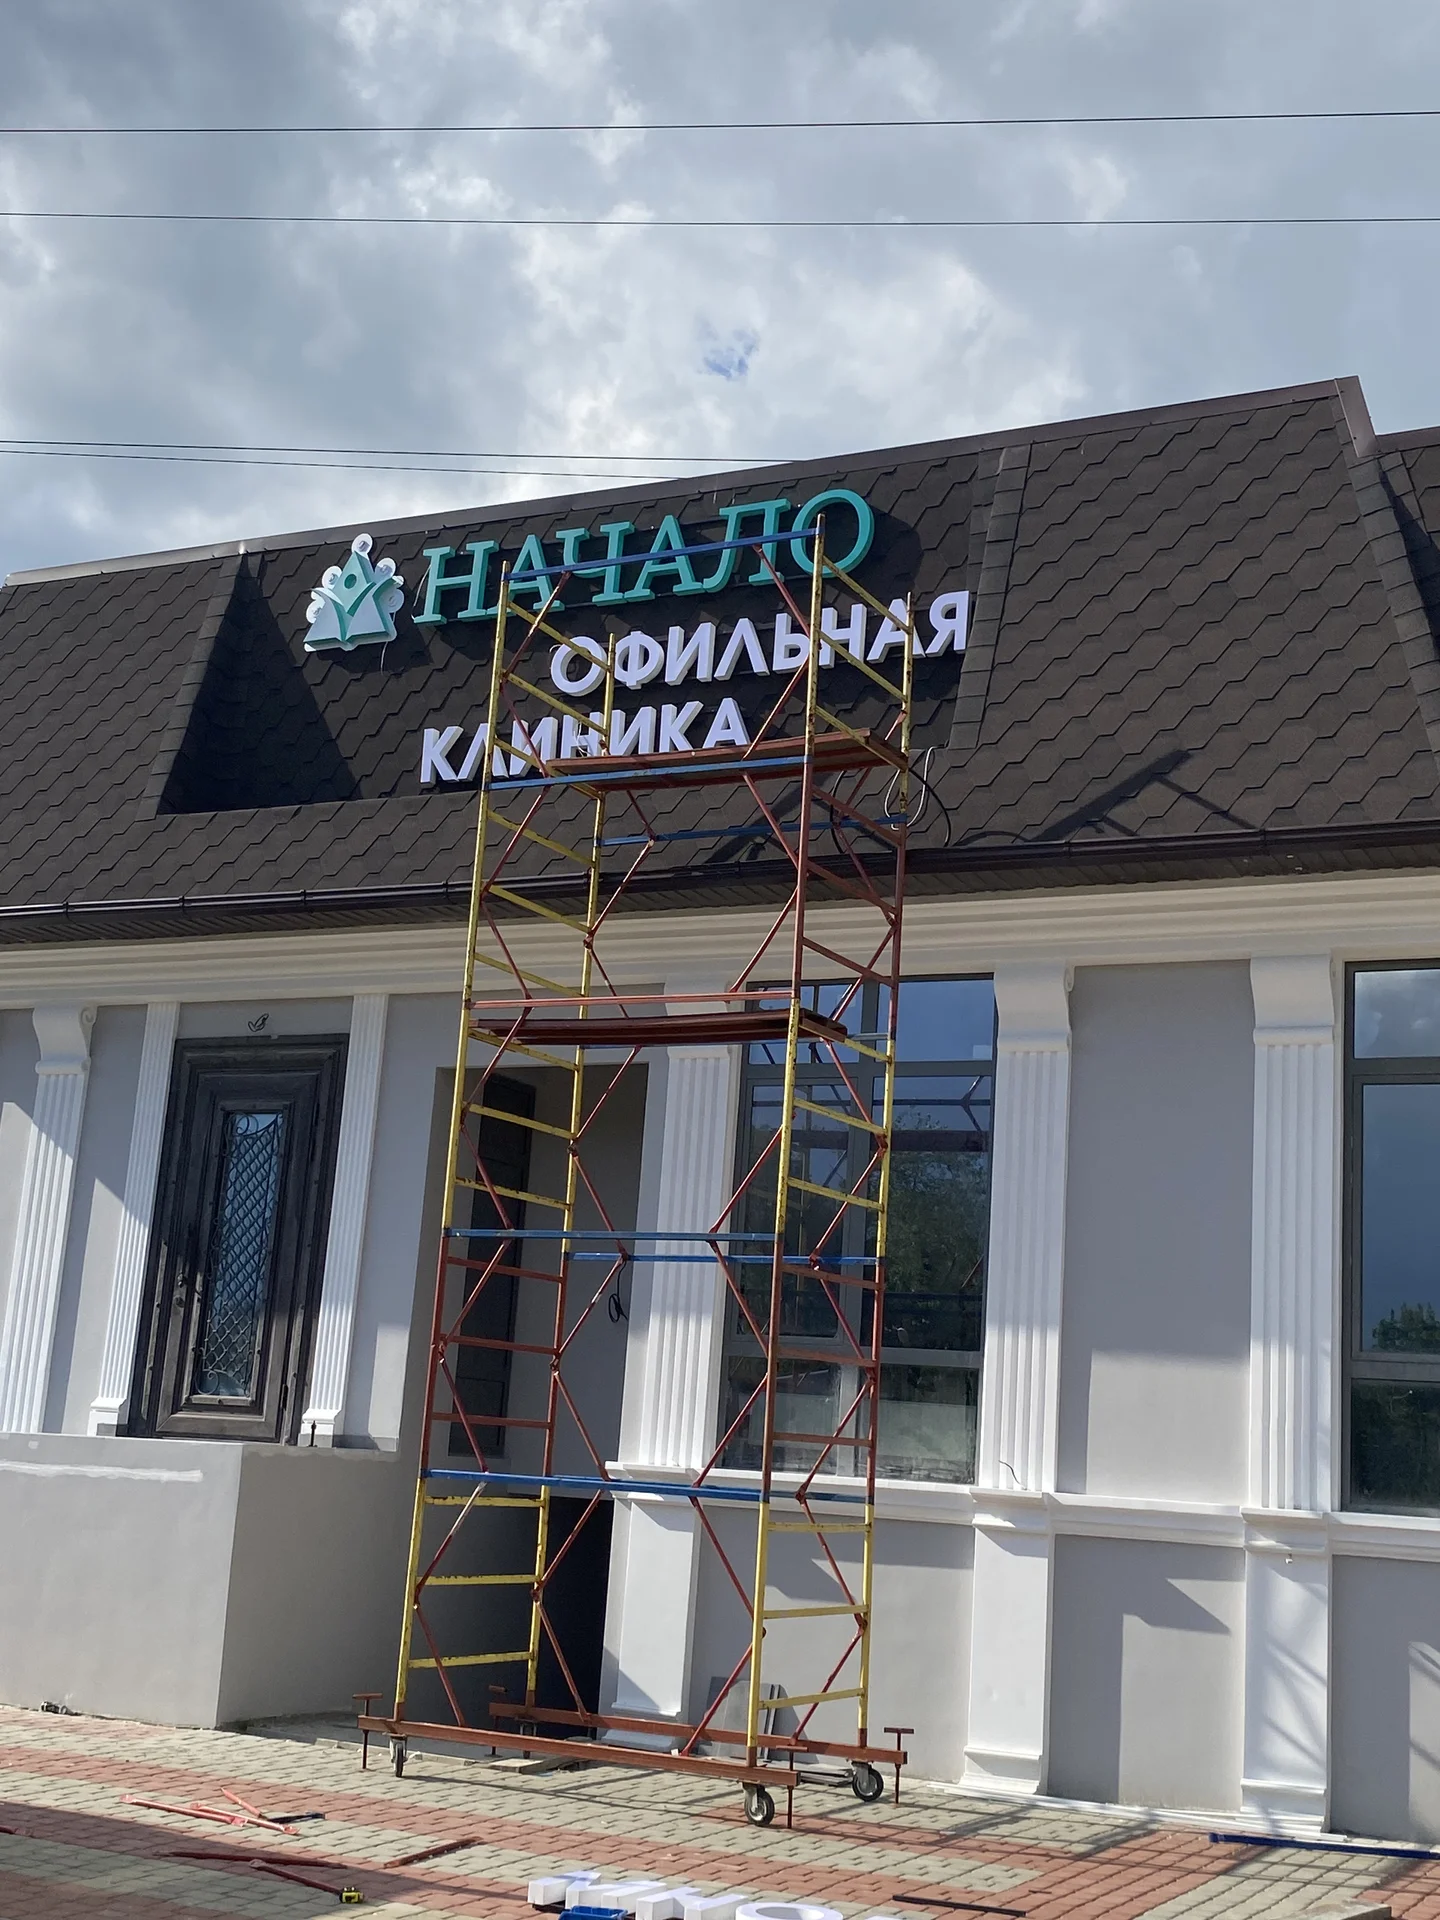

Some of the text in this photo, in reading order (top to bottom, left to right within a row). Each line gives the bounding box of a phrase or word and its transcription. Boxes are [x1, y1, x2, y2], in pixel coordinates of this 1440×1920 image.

[413, 488, 875, 626] НАЧАЛО
[550, 590, 970, 697] ОФИЛЬНАЯ
[420, 697, 751, 785] КЛИНИКА
